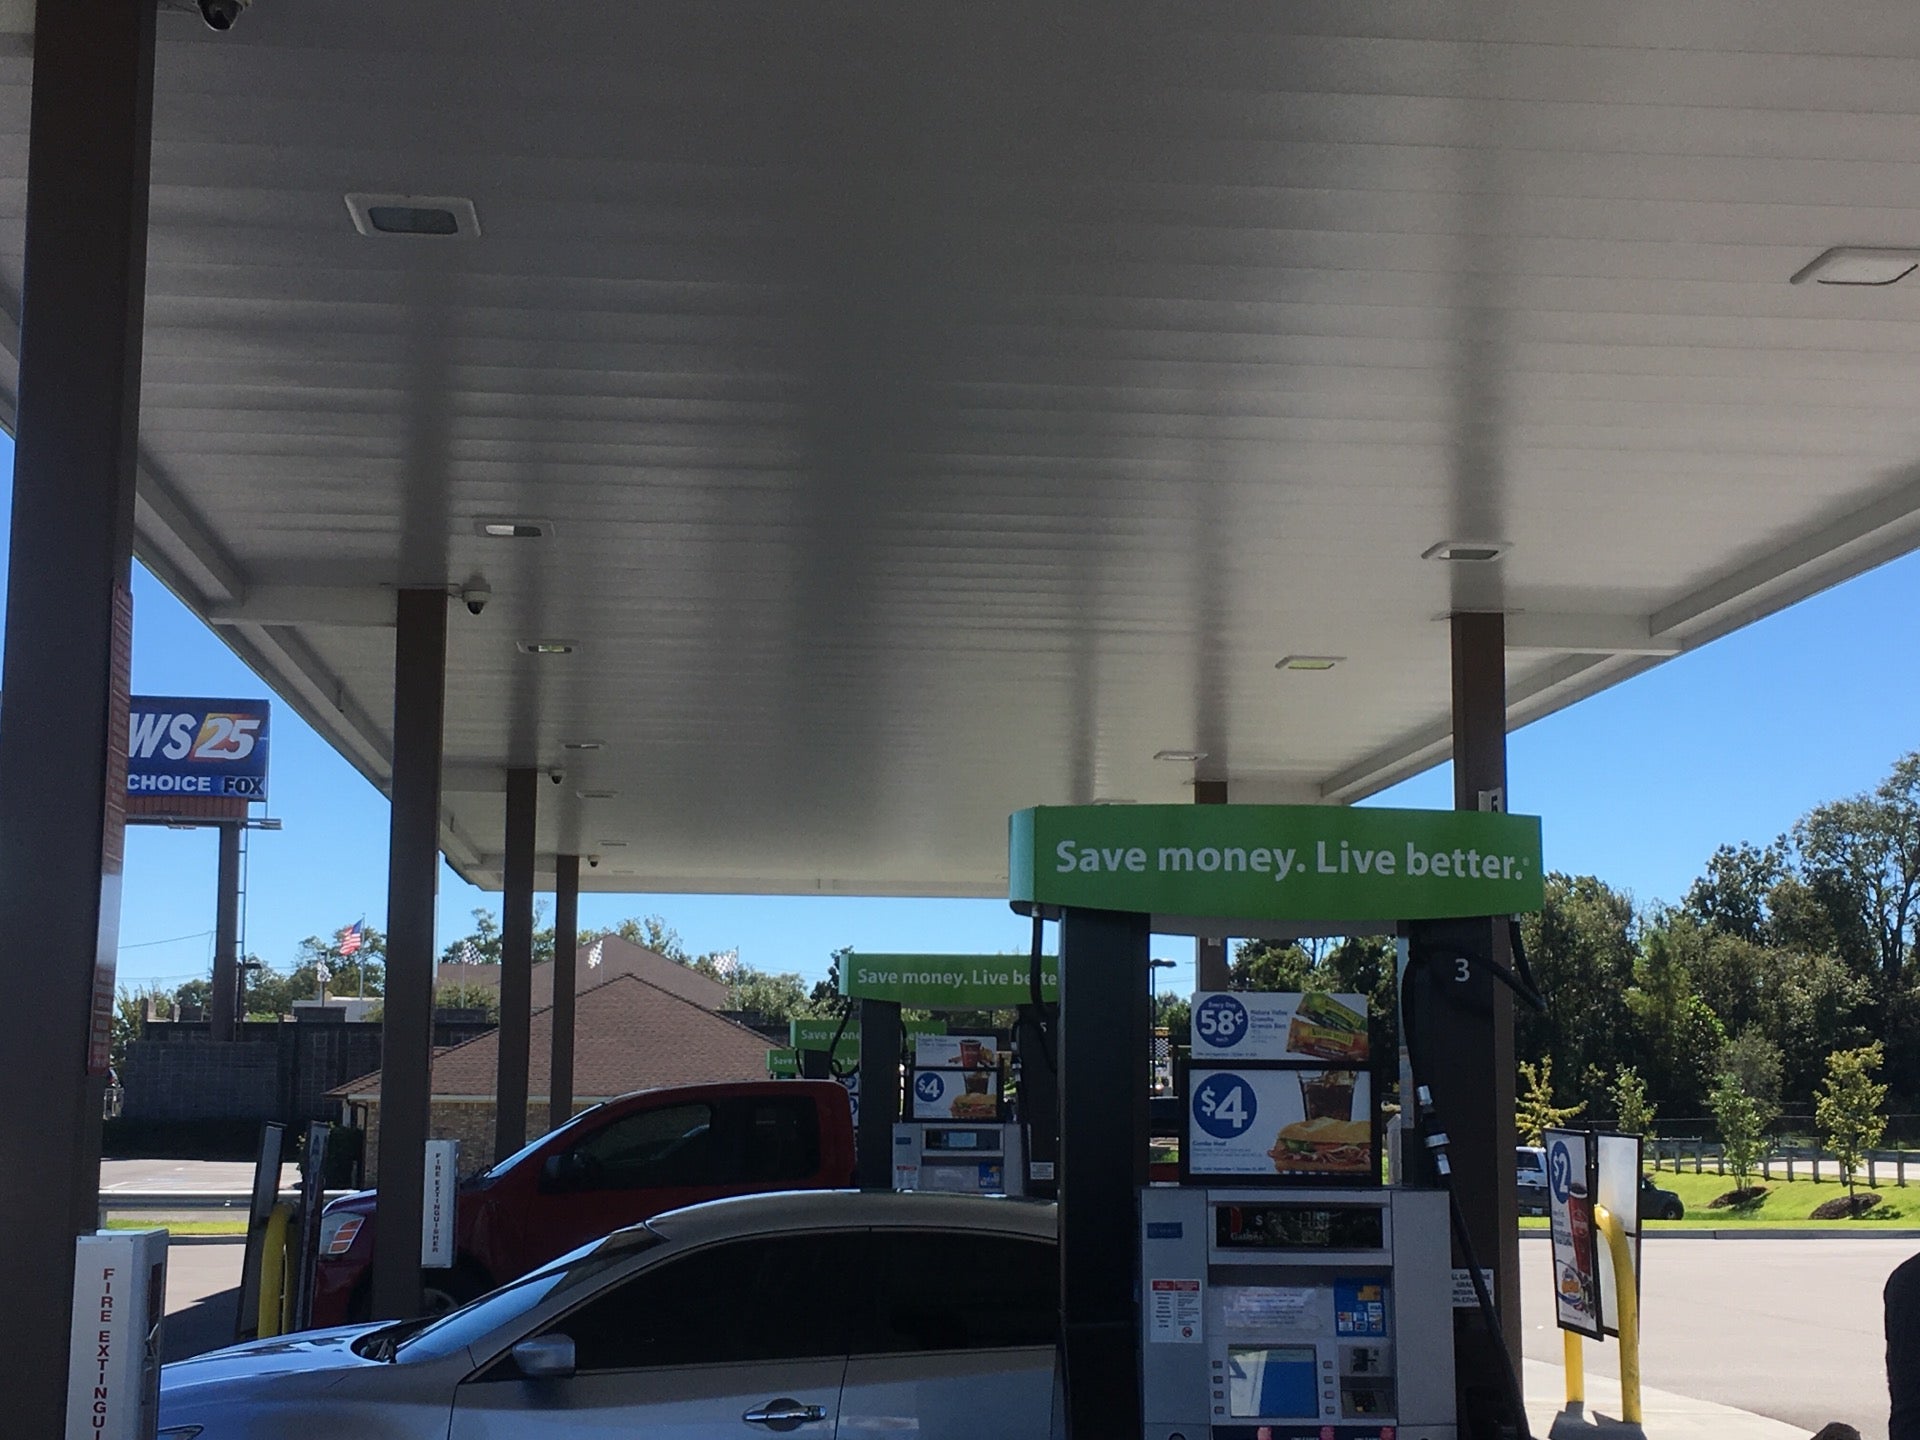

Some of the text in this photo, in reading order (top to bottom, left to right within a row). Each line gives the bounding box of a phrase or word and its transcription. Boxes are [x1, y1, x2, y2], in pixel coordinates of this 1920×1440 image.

[194, 717, 261, 760] 25
[127, 774, 211, 792] CHOICE
[223, 776, 265, 795] FOX
[1056, 840, 1147, 873] Save
[1158, 846, 1306, 882] money.
[1317, 841, 1396, 875] Live
[858, 968, 898, 985] Save
[902, 971, 968, 989] money.
[972, 969, 1009, 986] Live
[1454, 958, 1470, 982] 3
[801, 1029, 828, 1041] Save
[918, 1077, 941, 1098] $4
[1201, 1085, 1248, 1129] $4
[1552, 1150, 1569, 1193] $2
[99, 1267, 116, 1323] FIRE
